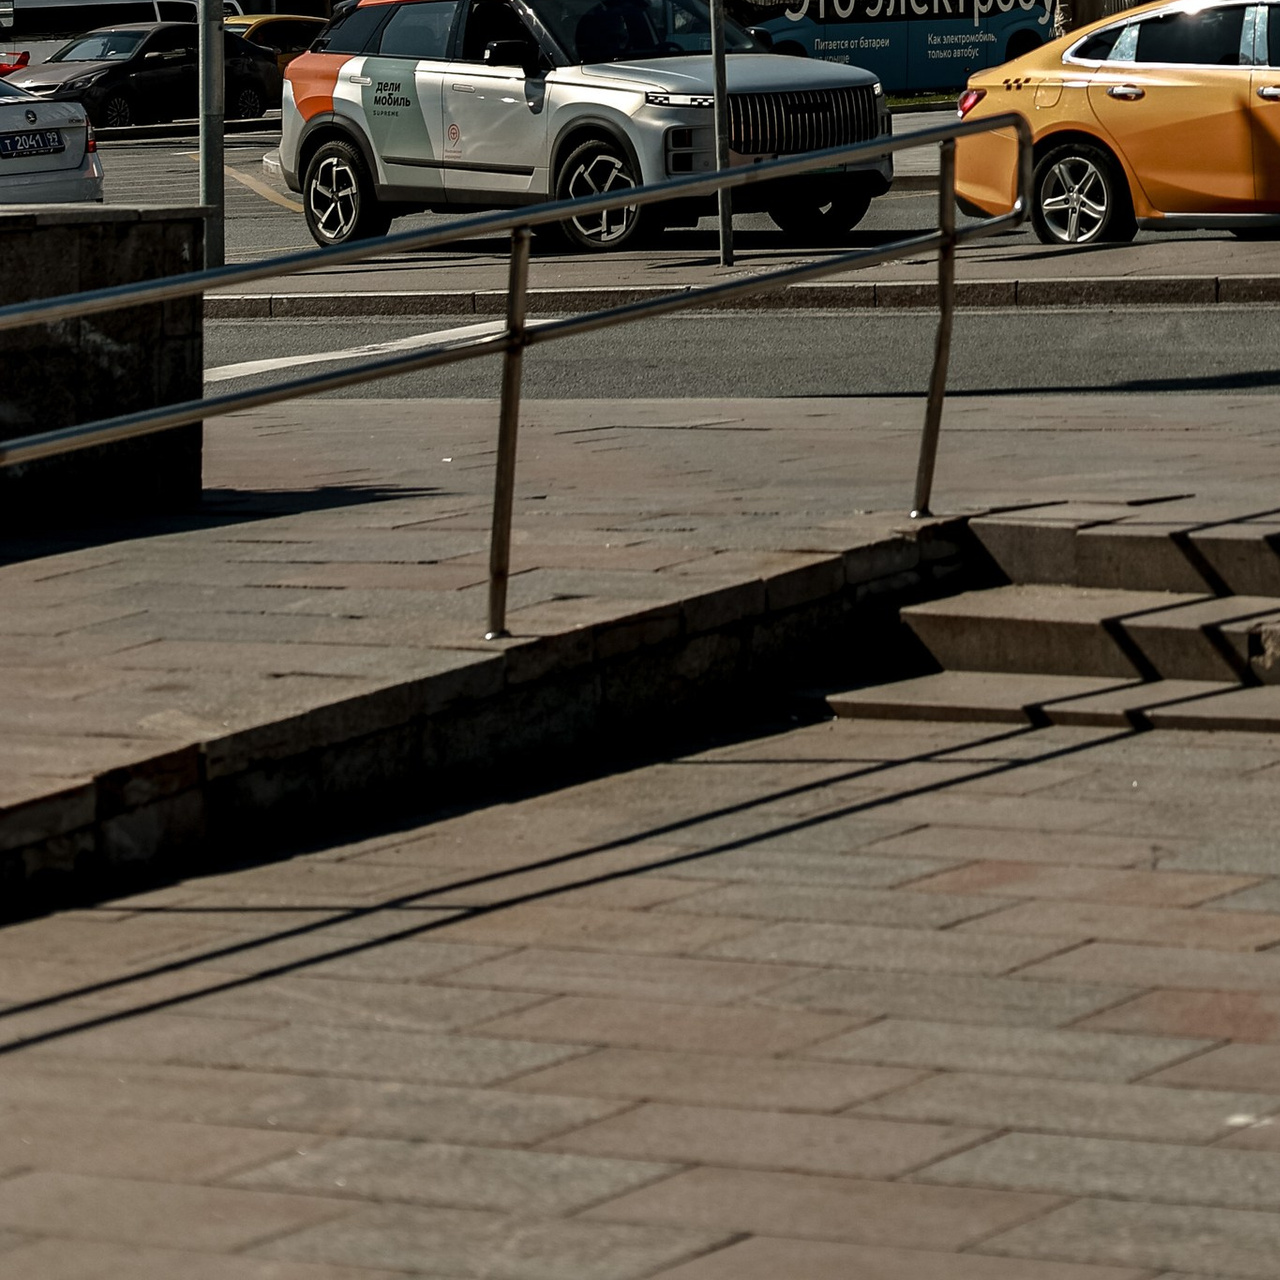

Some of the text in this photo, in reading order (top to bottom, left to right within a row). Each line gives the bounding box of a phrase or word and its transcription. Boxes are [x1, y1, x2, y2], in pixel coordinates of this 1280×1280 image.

[814, 36, 890, 51] Питается от батареи
[927, 31, 997, 46] Как электромобиль,
[927, 45, 979, 59] только автобус
[375, 81, 401, 94] дели
[373, 92, 411, 107] мобиль
[14, 134, 43, 150] 2041
[46, 132, 58, 142] 99
